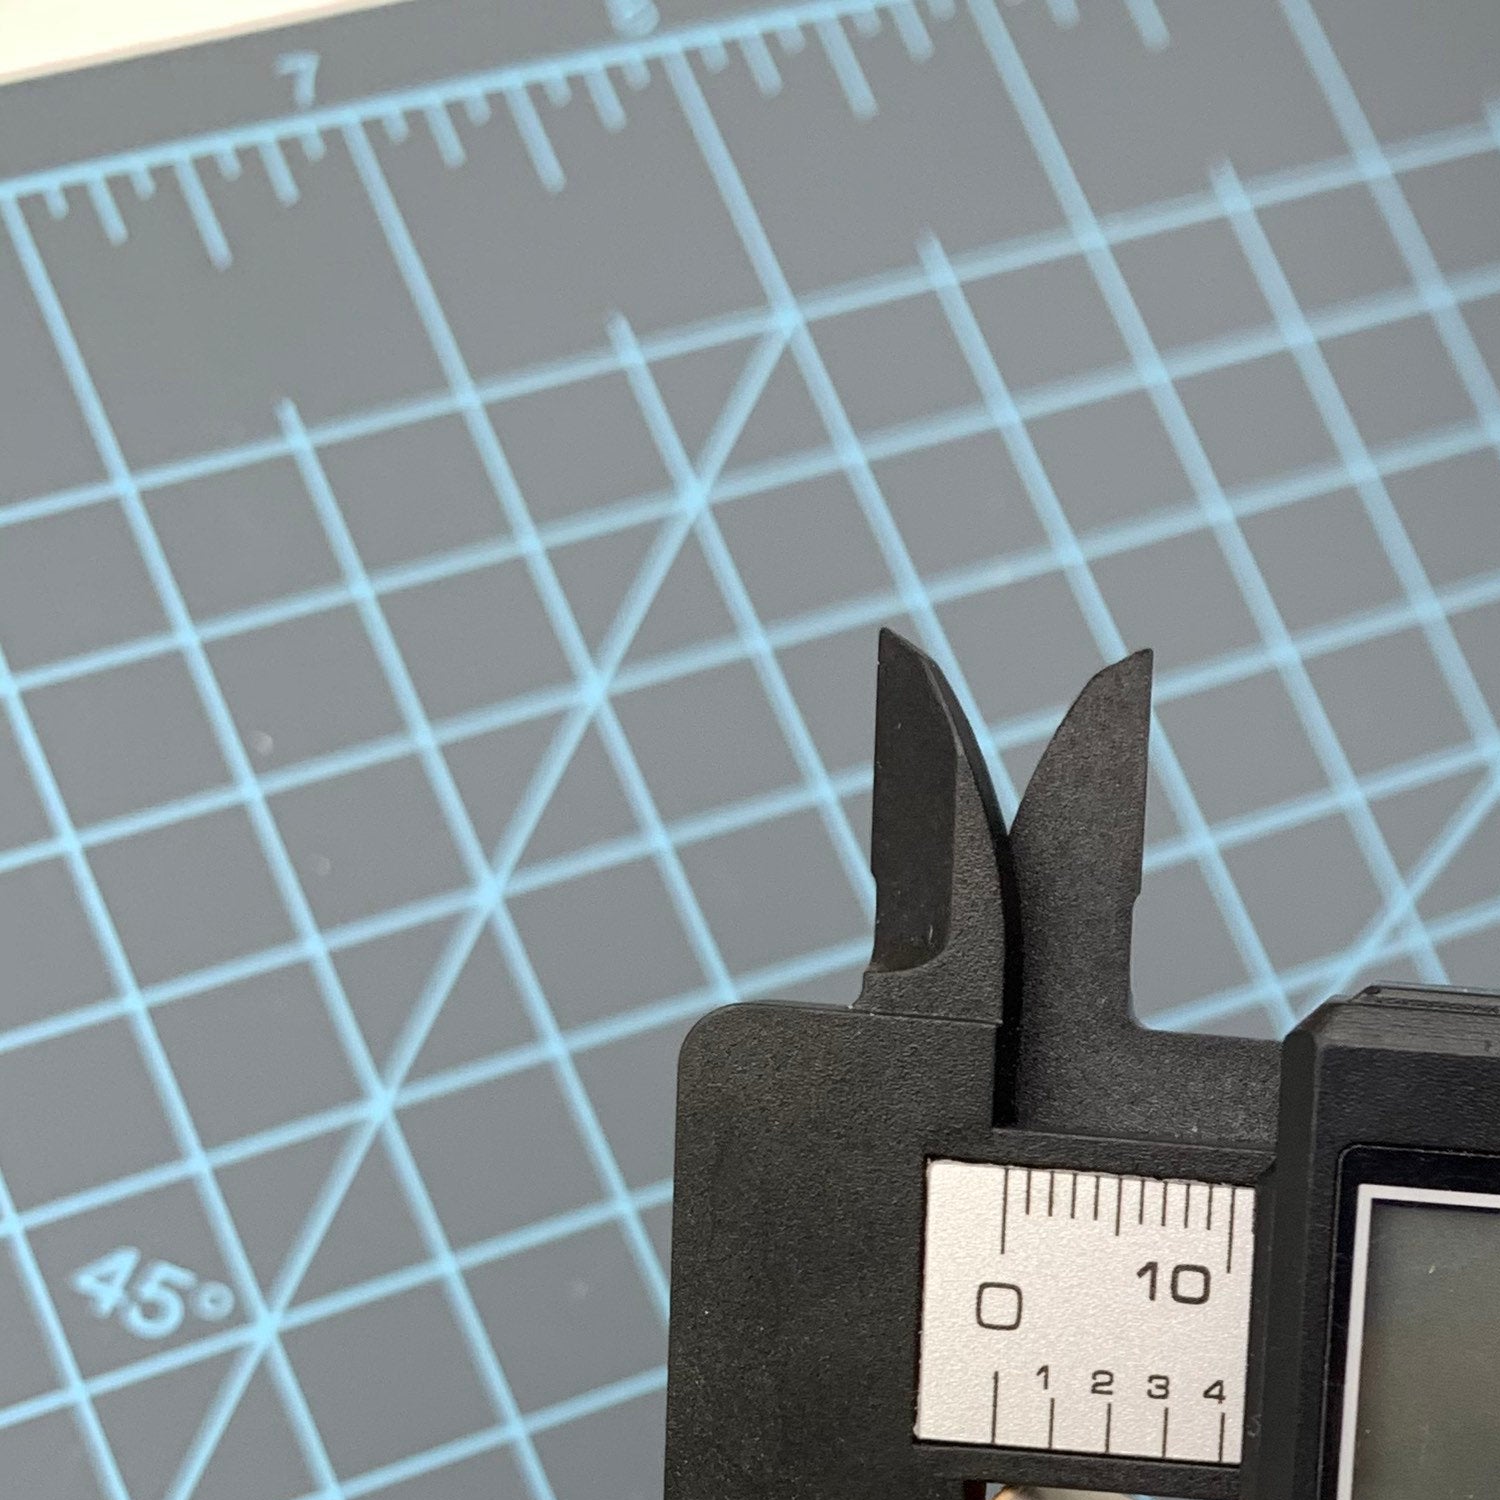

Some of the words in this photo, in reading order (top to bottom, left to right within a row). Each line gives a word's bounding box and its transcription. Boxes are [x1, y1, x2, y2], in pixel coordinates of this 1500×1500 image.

[273, 50, 319, 106] 7
[975, 1281, 1023, 1331] 0
[1136, 1261, 1211, 1305] 10
[1035, 1364, 1050, 1390] 1
[1090, 1369, 1115, 1396] 2
[1146, 1374, 1171, 1401] 3
[1202, 1379, 1227, 1405] 4
